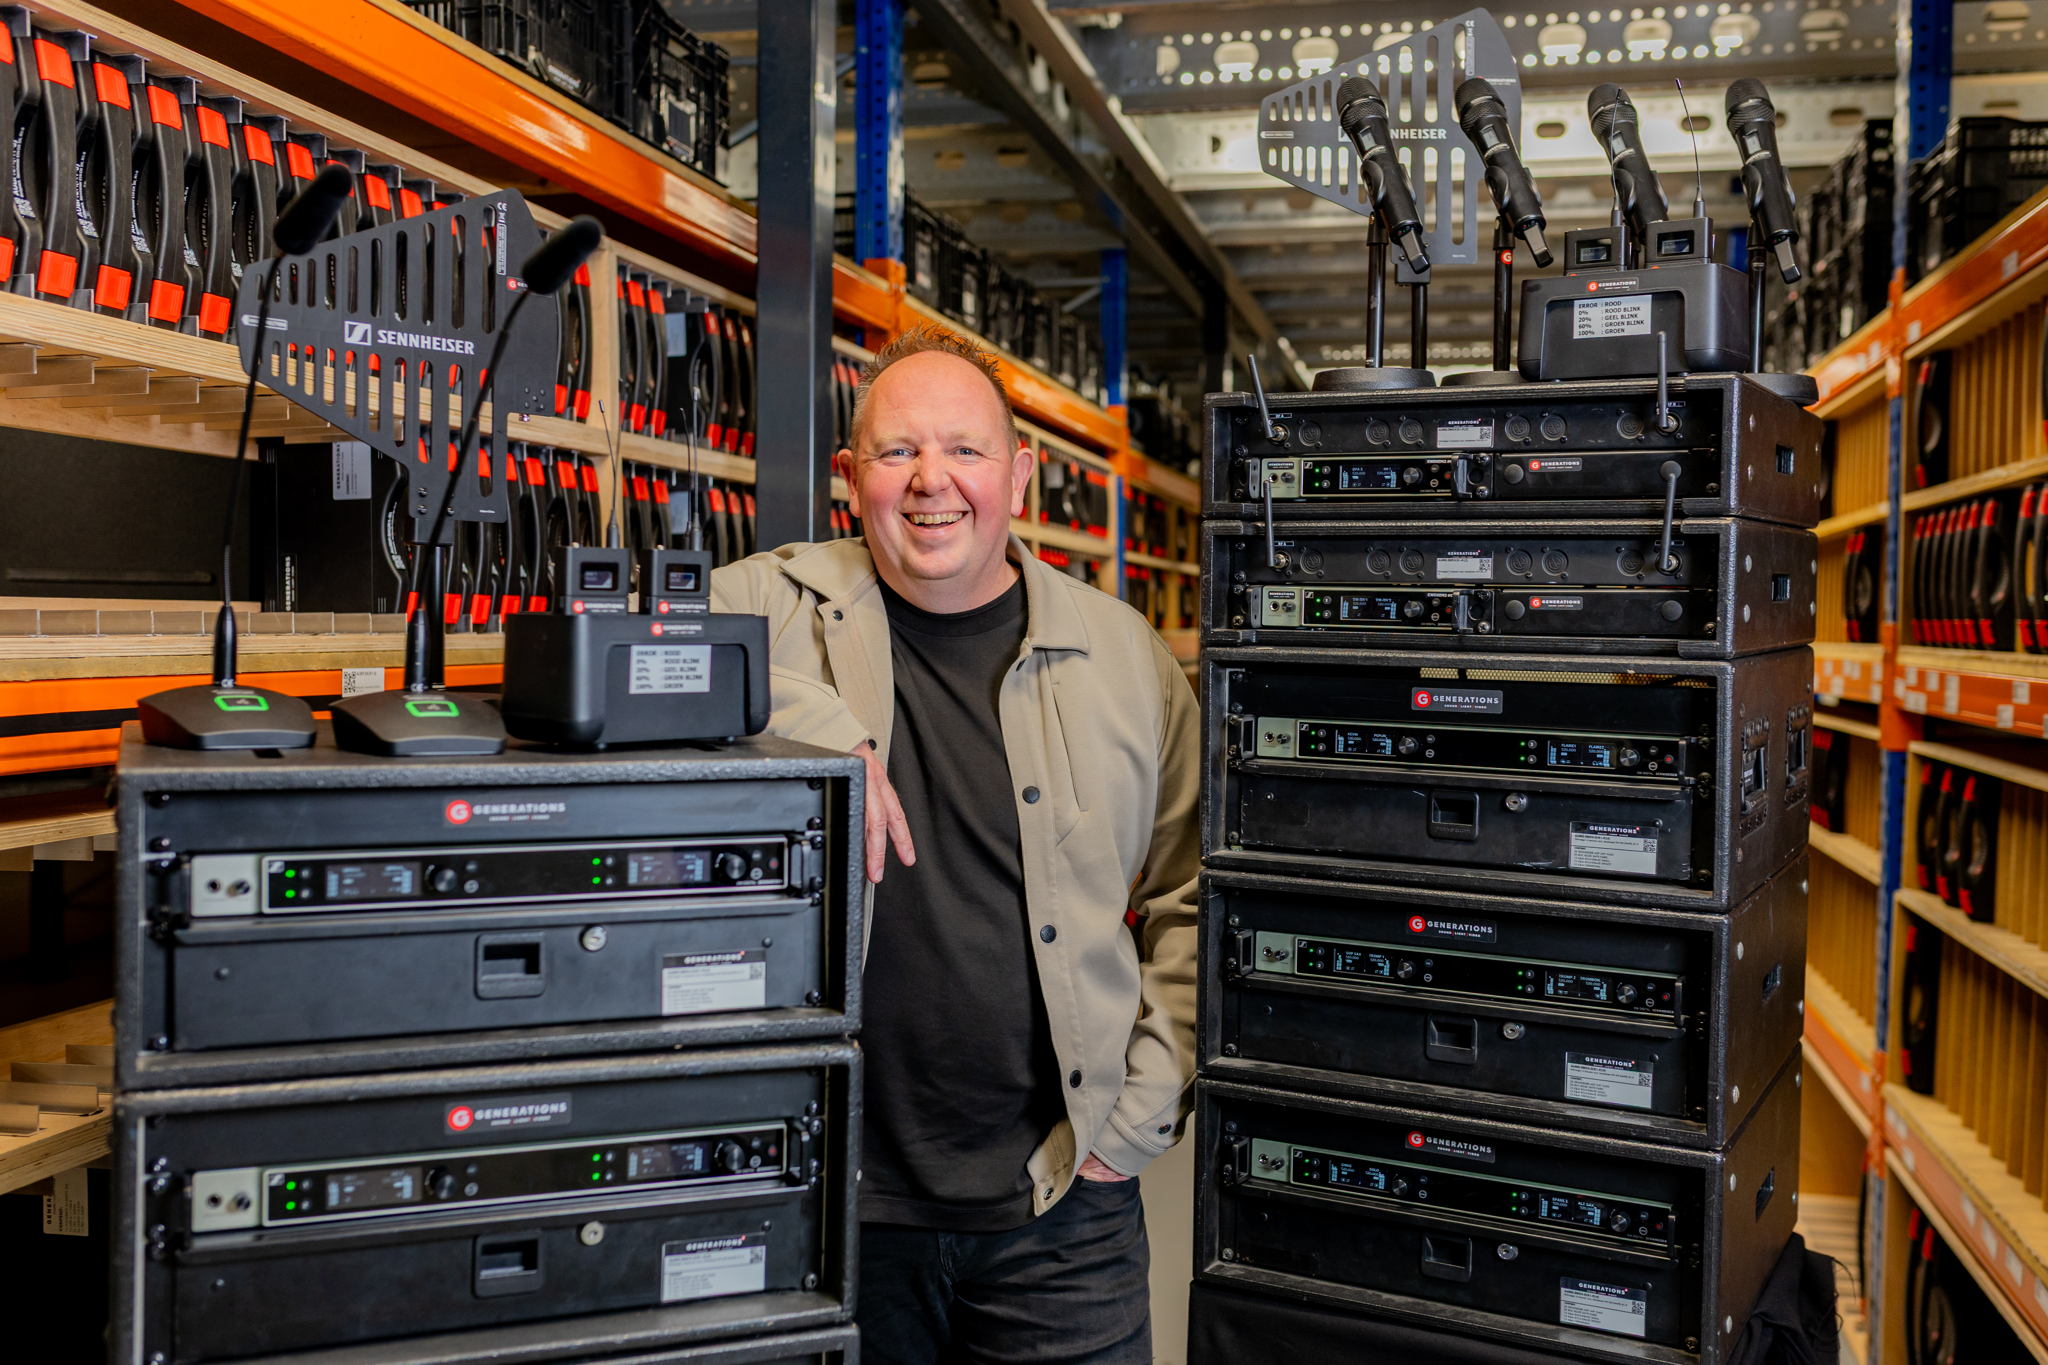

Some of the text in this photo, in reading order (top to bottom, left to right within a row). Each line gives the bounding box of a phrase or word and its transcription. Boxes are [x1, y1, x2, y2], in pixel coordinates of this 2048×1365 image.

[1391, 128, 1447, 140] NHEISER
[377, 330, 474, 354] SENNHEISER
[1433, 696, 1499, 704] GENERATIONS
[472, 802, 566, 815] GENERATIONS
[1590, 825, 1638, 834] GENERATIONS
[1427, 920, 1493, 934] GENERATIONS
[684, 954, 742, 965] GENERATIONS
[1585, 1056, 1632, 1068] GENERATIONS
[474, 1102, 568, 1120] GENERATIONS
[1426, 1136, 1492, 1154] GENERATIONS
[686, 1238, 742, 1252] GENERATIONS
[1578, 1282, 1626, 1294] GENERATIONS
